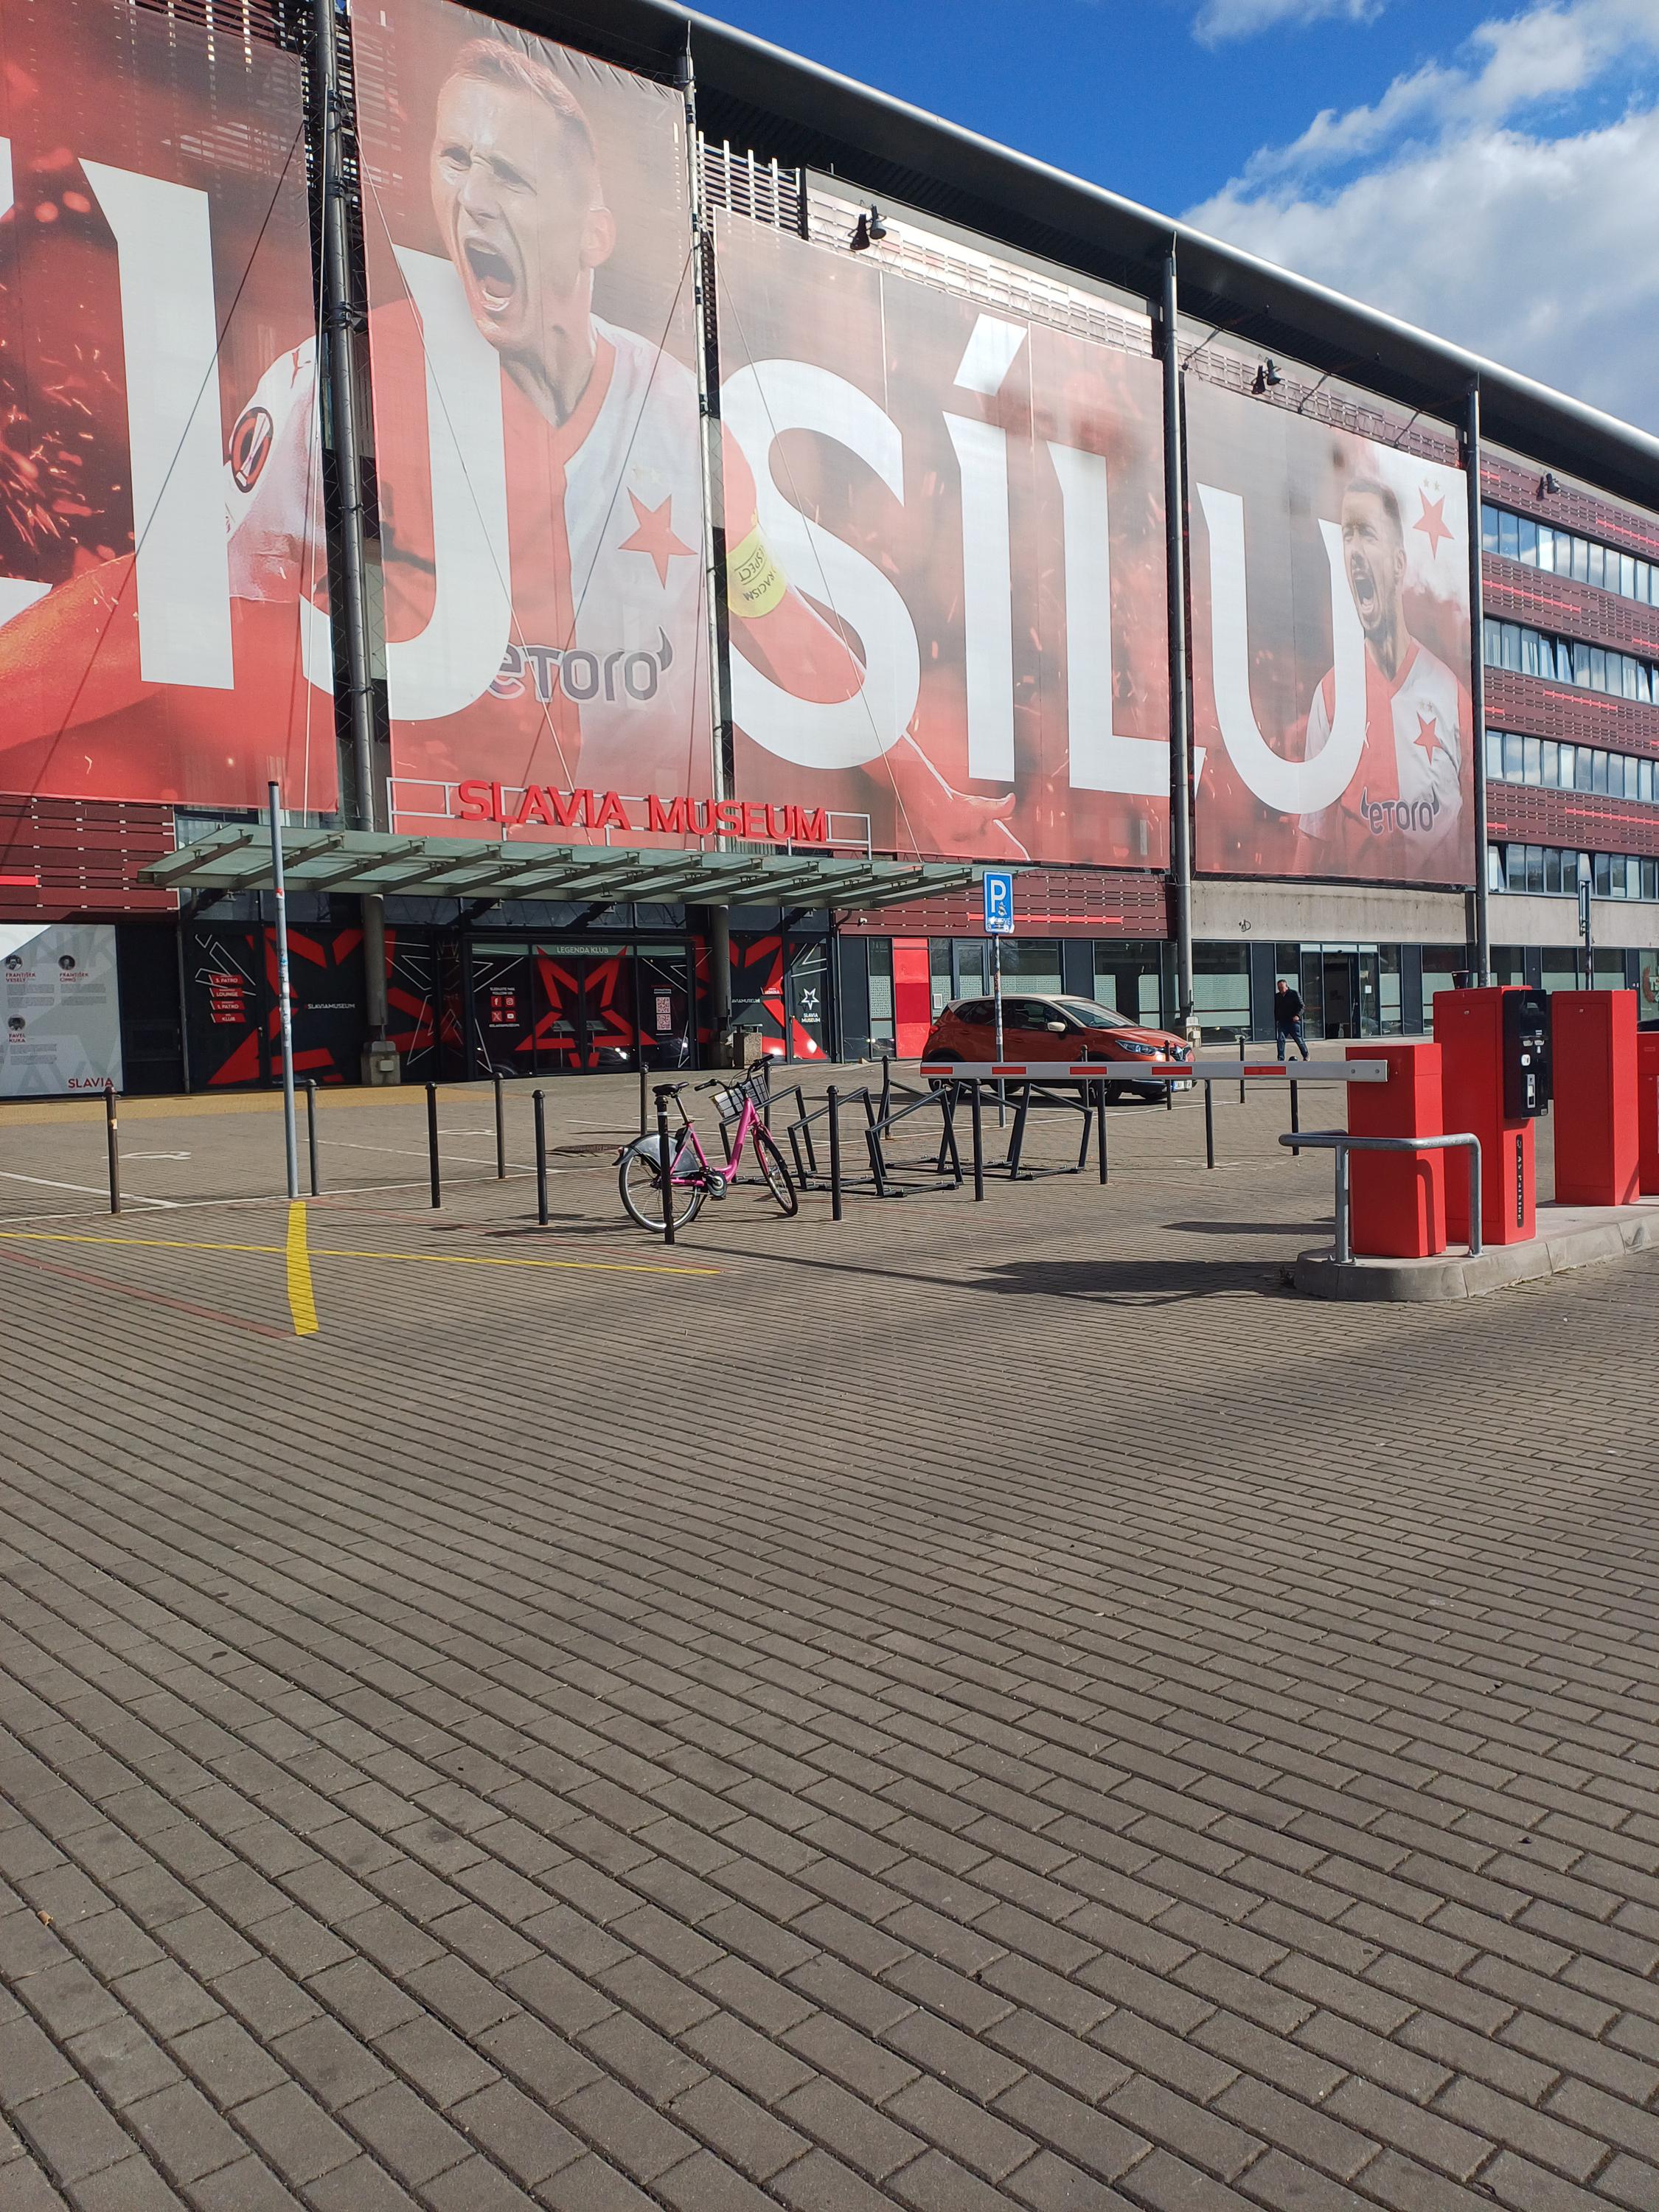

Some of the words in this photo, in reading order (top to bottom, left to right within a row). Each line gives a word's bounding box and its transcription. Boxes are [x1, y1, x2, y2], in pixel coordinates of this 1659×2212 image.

[459, 779, 633, 831] SLAVIA
[647, 793, 827, 843] MUSEUM
[990, 879, 1006, 913] P
[68, 1077, 114, 1088] SLAVIA
